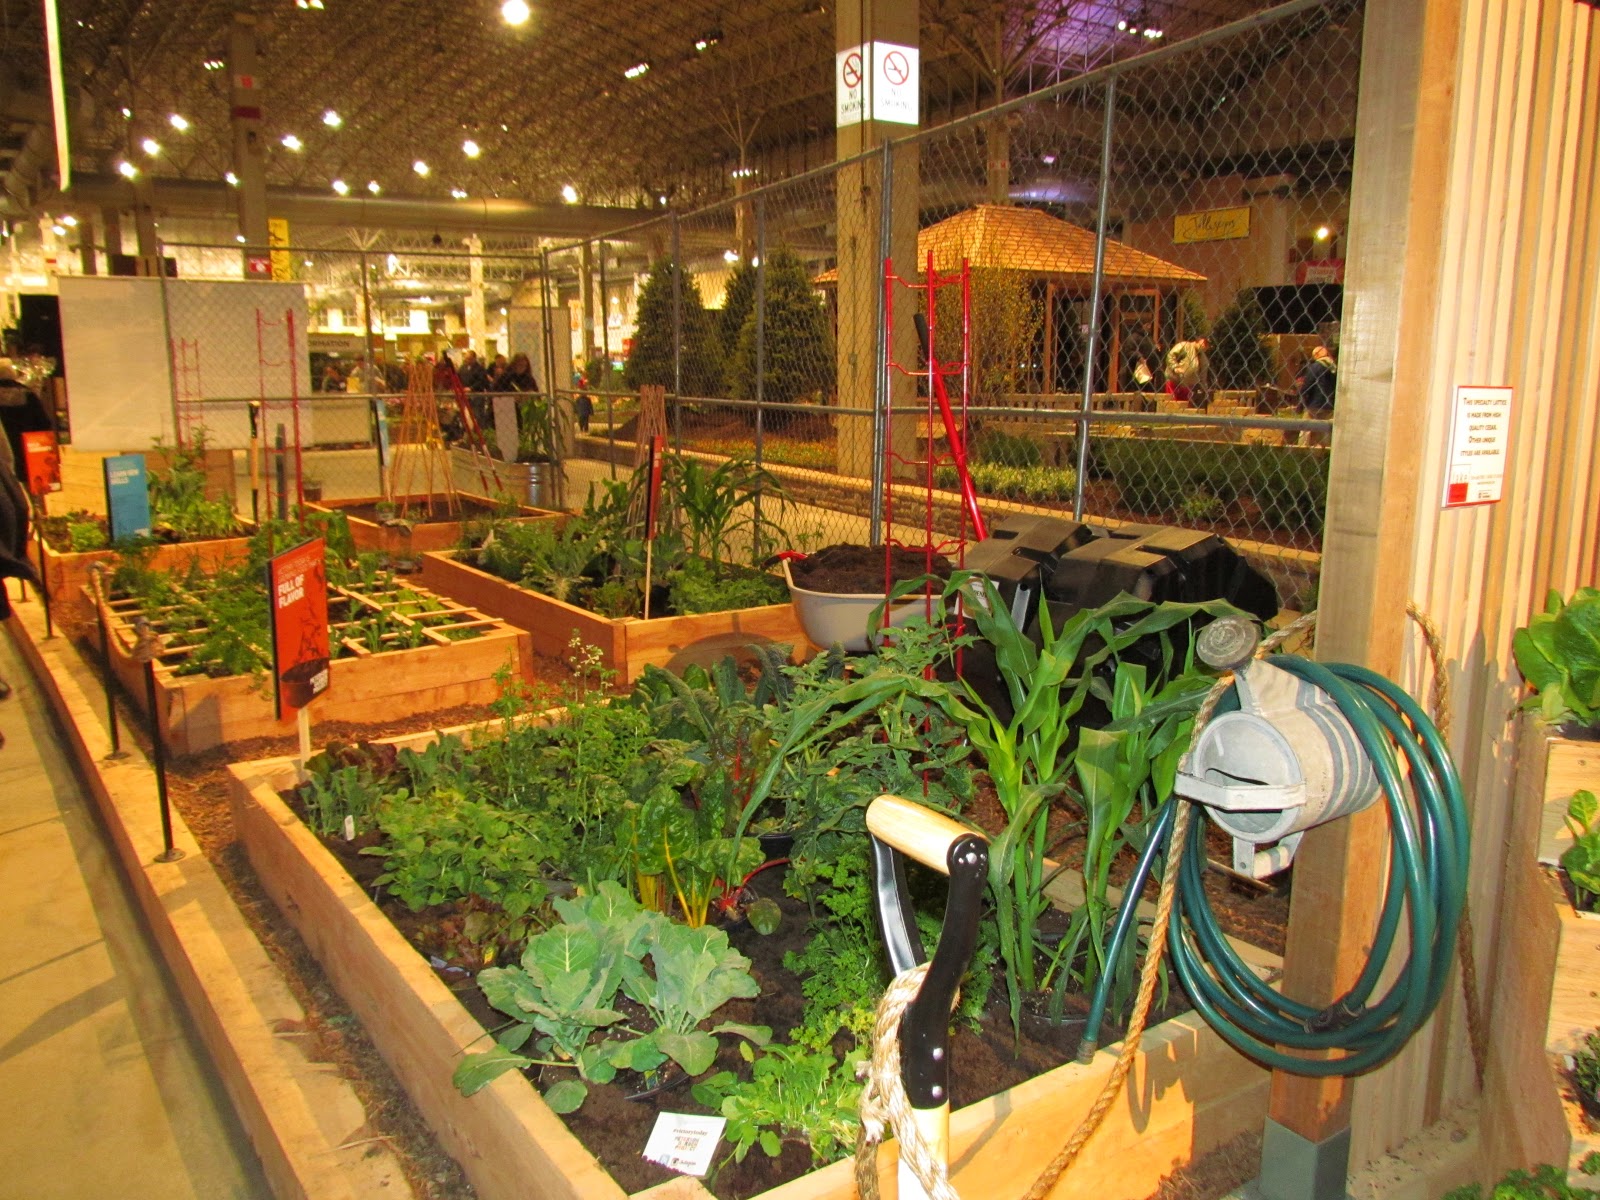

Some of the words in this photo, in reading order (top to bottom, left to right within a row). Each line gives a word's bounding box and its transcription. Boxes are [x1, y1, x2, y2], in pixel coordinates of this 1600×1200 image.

[849, 89, 858, 100] NO
[841, 98, 866, 114] SMOKING
[308, 339, 350, 348] ORMATION
[278, 580, 295, 596] FULL
[295, 573, 304, 587] OF
[278, 587, 305, 608] FLAVOR
[673, 1128, 708, 1136] #victorytoday
